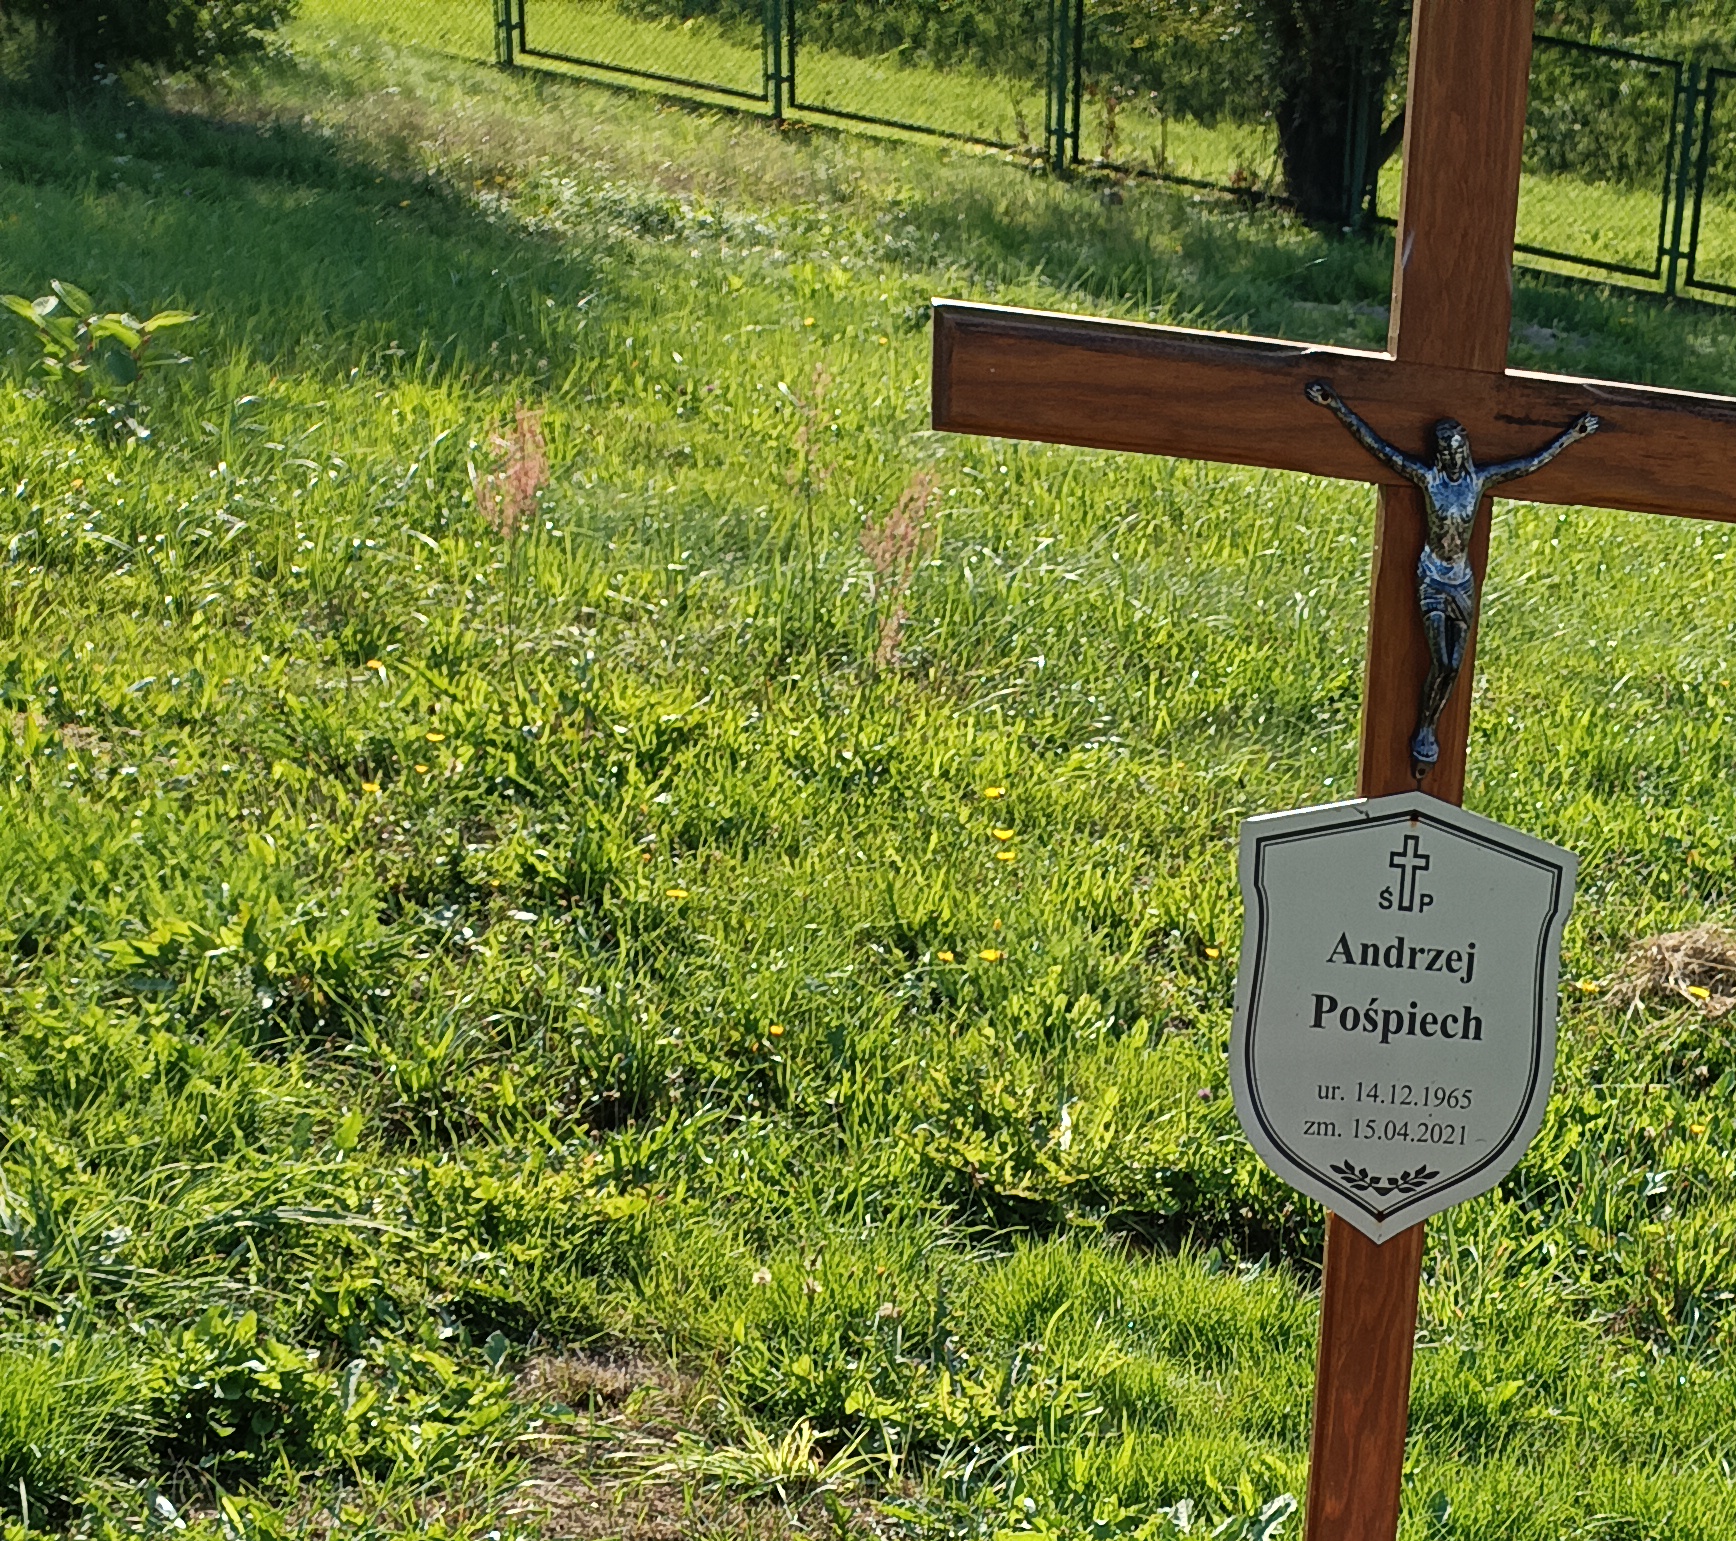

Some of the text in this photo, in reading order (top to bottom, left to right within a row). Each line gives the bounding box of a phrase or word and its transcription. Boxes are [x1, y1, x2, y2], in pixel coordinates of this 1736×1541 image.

[1378, 886, 1434, 913] Ś P
[1326, 931, 1477, 984] Andrzej
[1309, 993, 1484, 1044] Pośpiech
[1316, 1081, 1473, 1109] ur. 14.12.1965
[1303, 1118, 1467, 1146] zm. 15.04.2021
